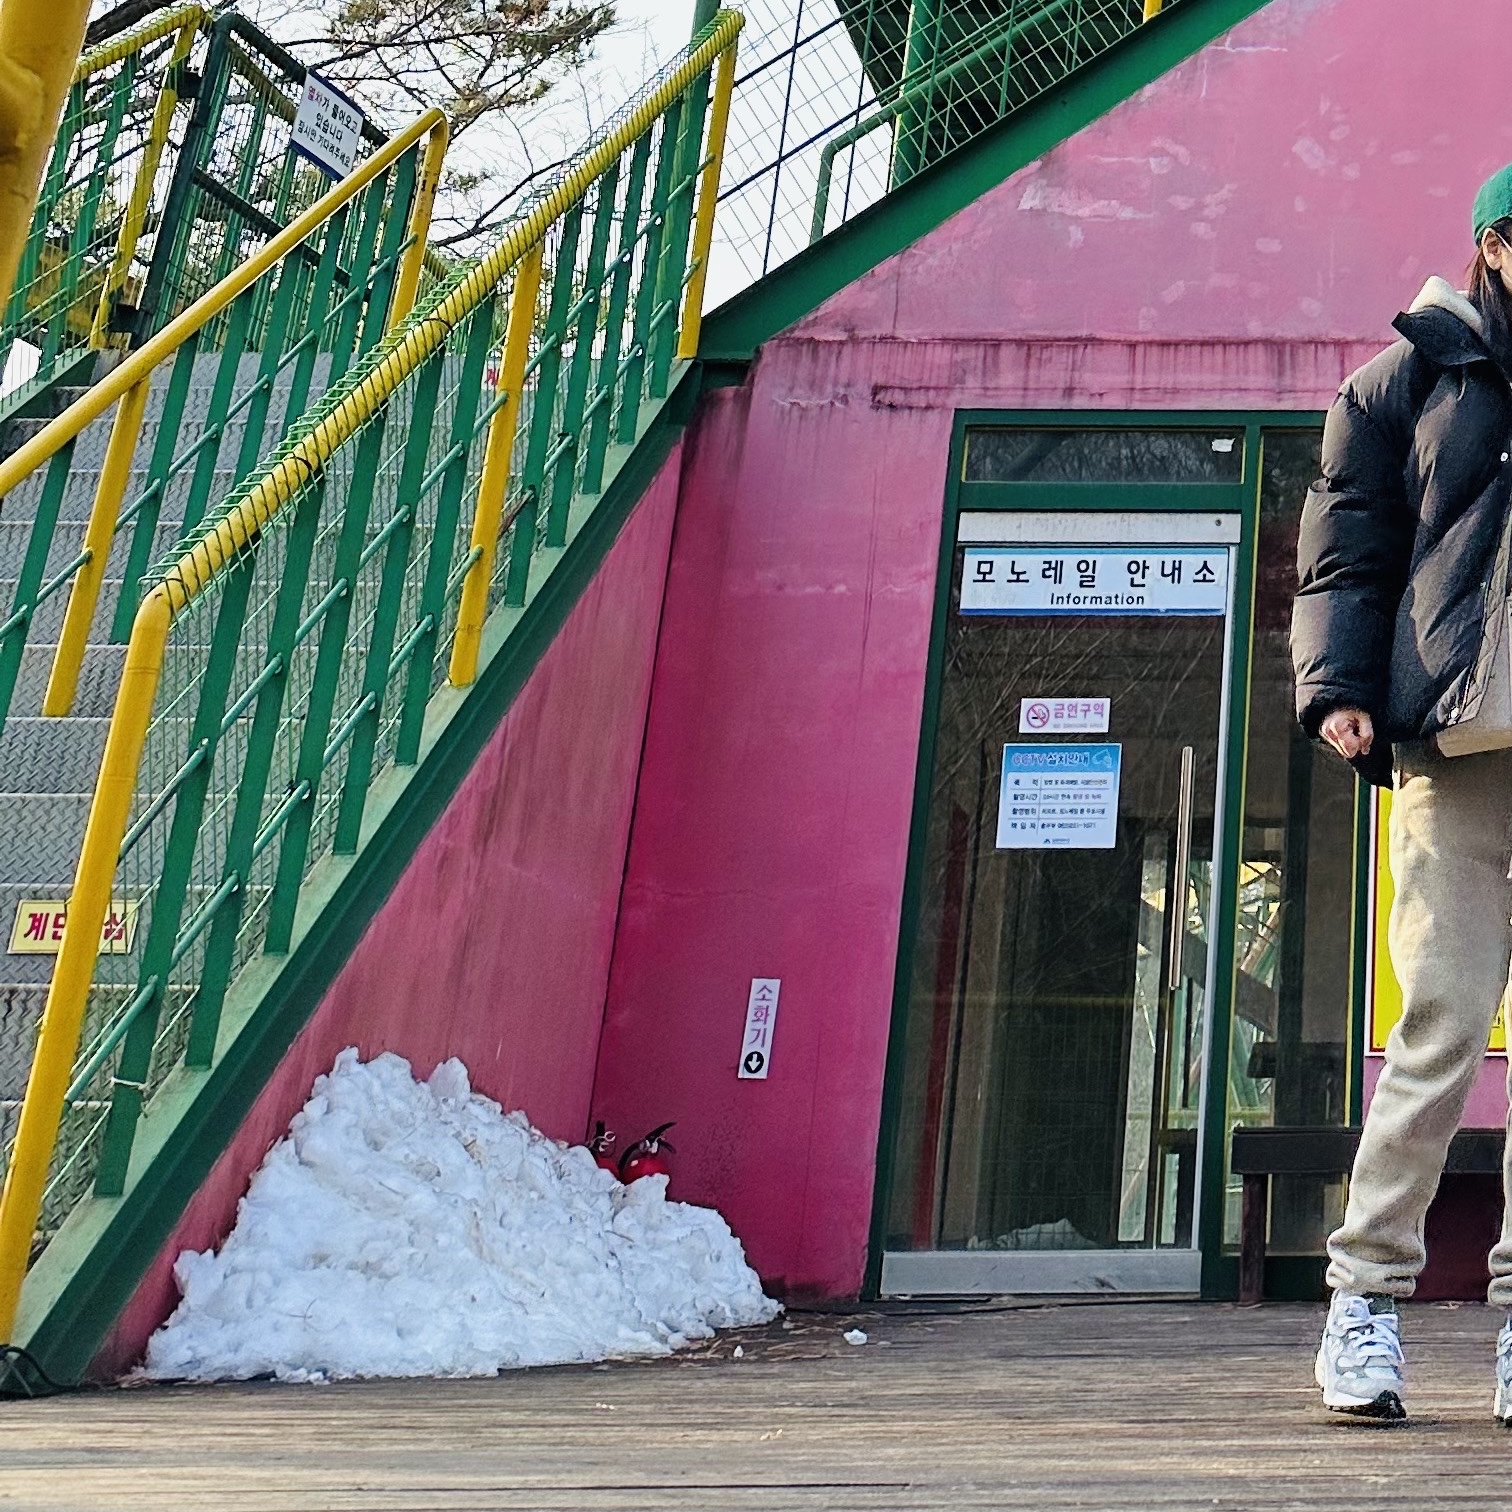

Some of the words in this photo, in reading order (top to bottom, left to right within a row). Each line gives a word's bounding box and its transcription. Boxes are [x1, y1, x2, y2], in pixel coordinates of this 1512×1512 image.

[315, 112, 344, 144] 있습니다
[972, 559, 1098, 589] 모노레일
[1126, 559, 1217, 588] 안내소
[1049, 592, 1145, 606] Information
[1053, 702, 1105, 719] 금연구역
[747, 984, 773, 1049] 소화기
